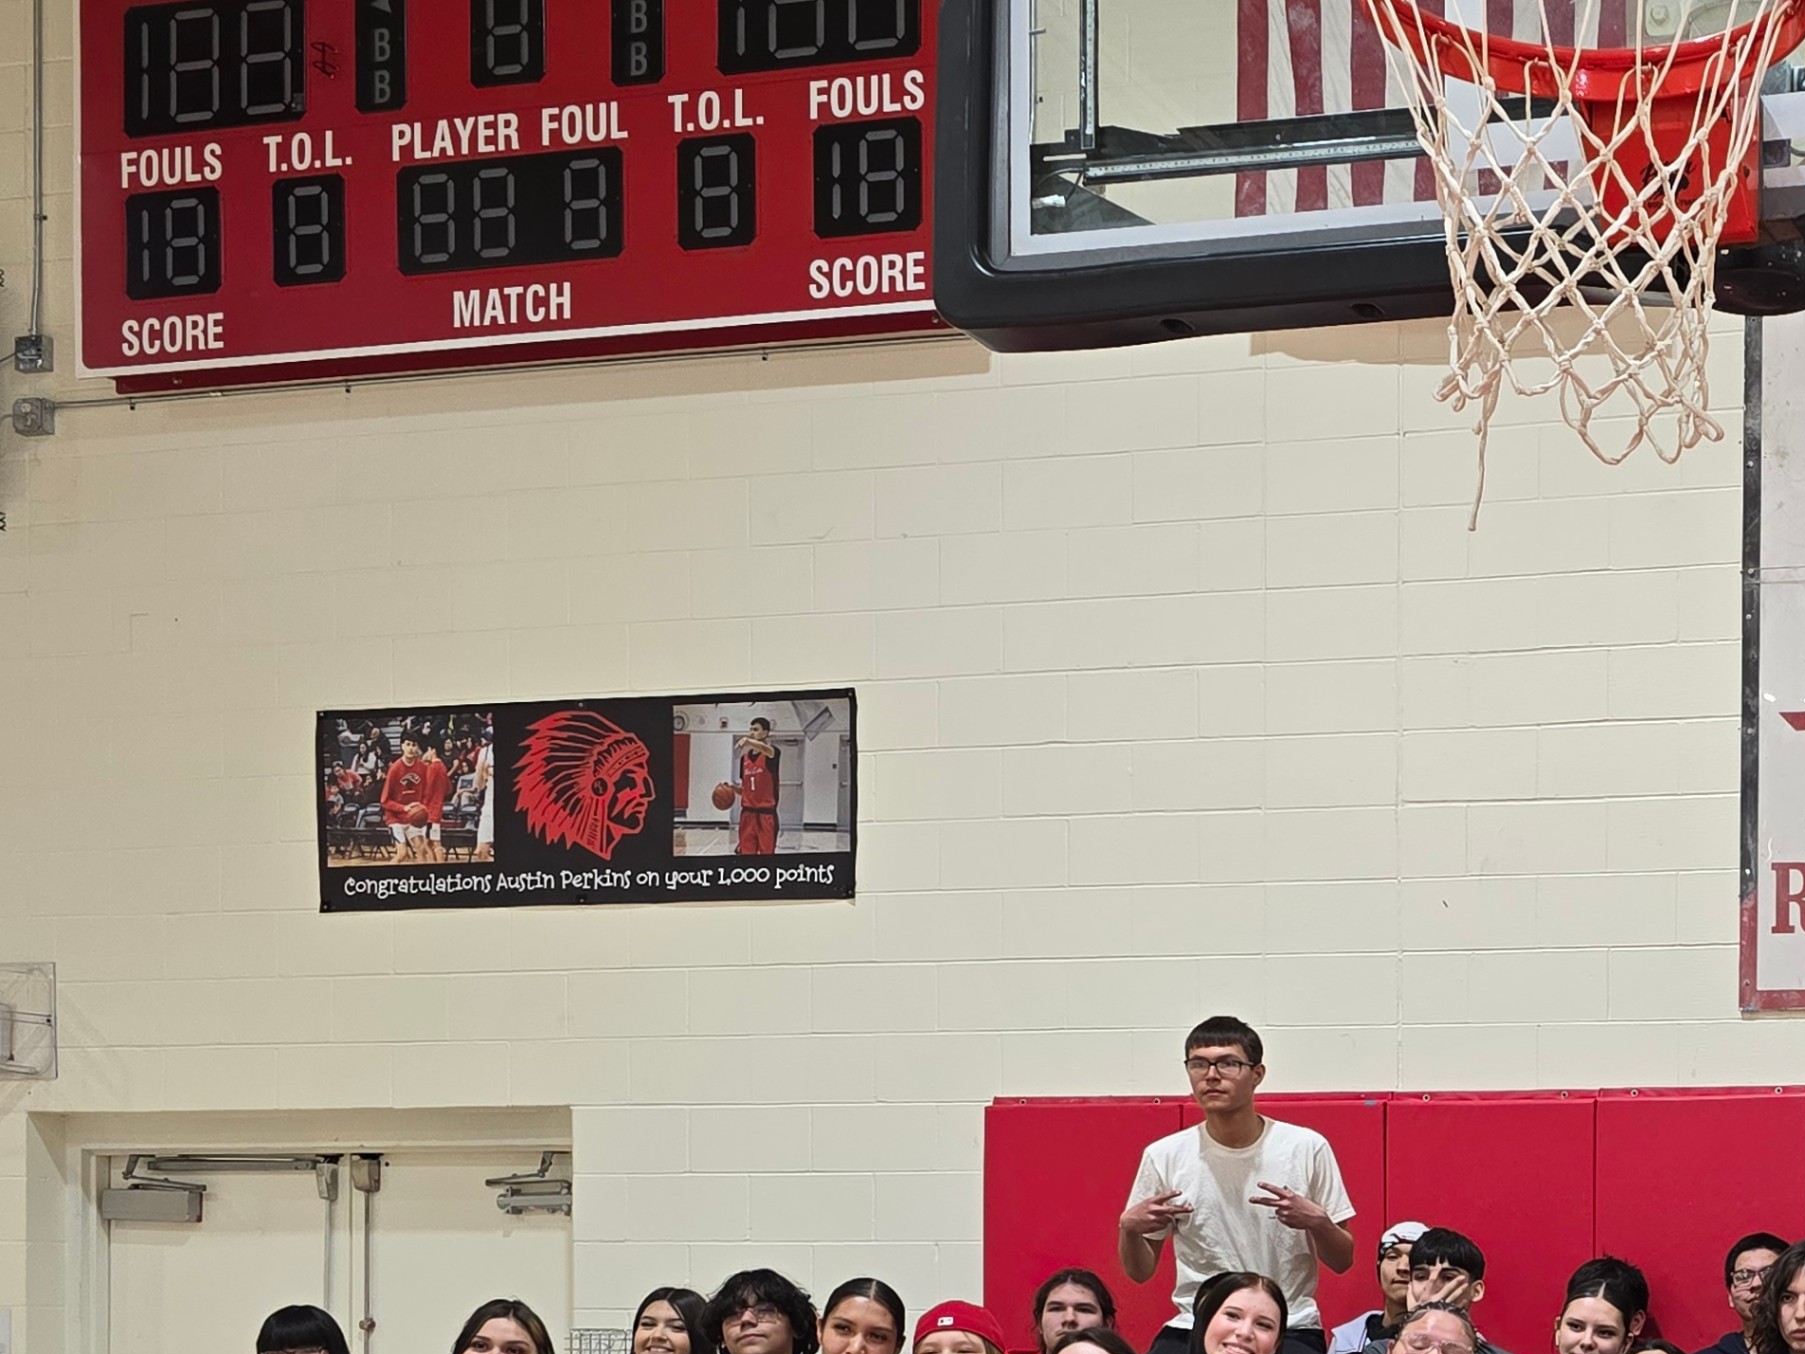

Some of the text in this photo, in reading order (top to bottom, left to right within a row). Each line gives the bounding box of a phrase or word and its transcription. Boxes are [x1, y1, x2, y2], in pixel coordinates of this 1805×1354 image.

[667, 88, 765, 133] T.O.L.
[809, 70, 925, 120] FOULS
[263, 130, 353, 173] T.O.L.
[391, 101, 628, 162] PLAYER FOUL
[121, 142, 222, 189] FOULS
[809, 251, 926, 299] SCORE
[453, 281, 572, 328] MATCH
[121, 312, 224, 357] SCORE
[344, 864, 835, 899] Congratulations Austin Perkins on your 1,000 points
